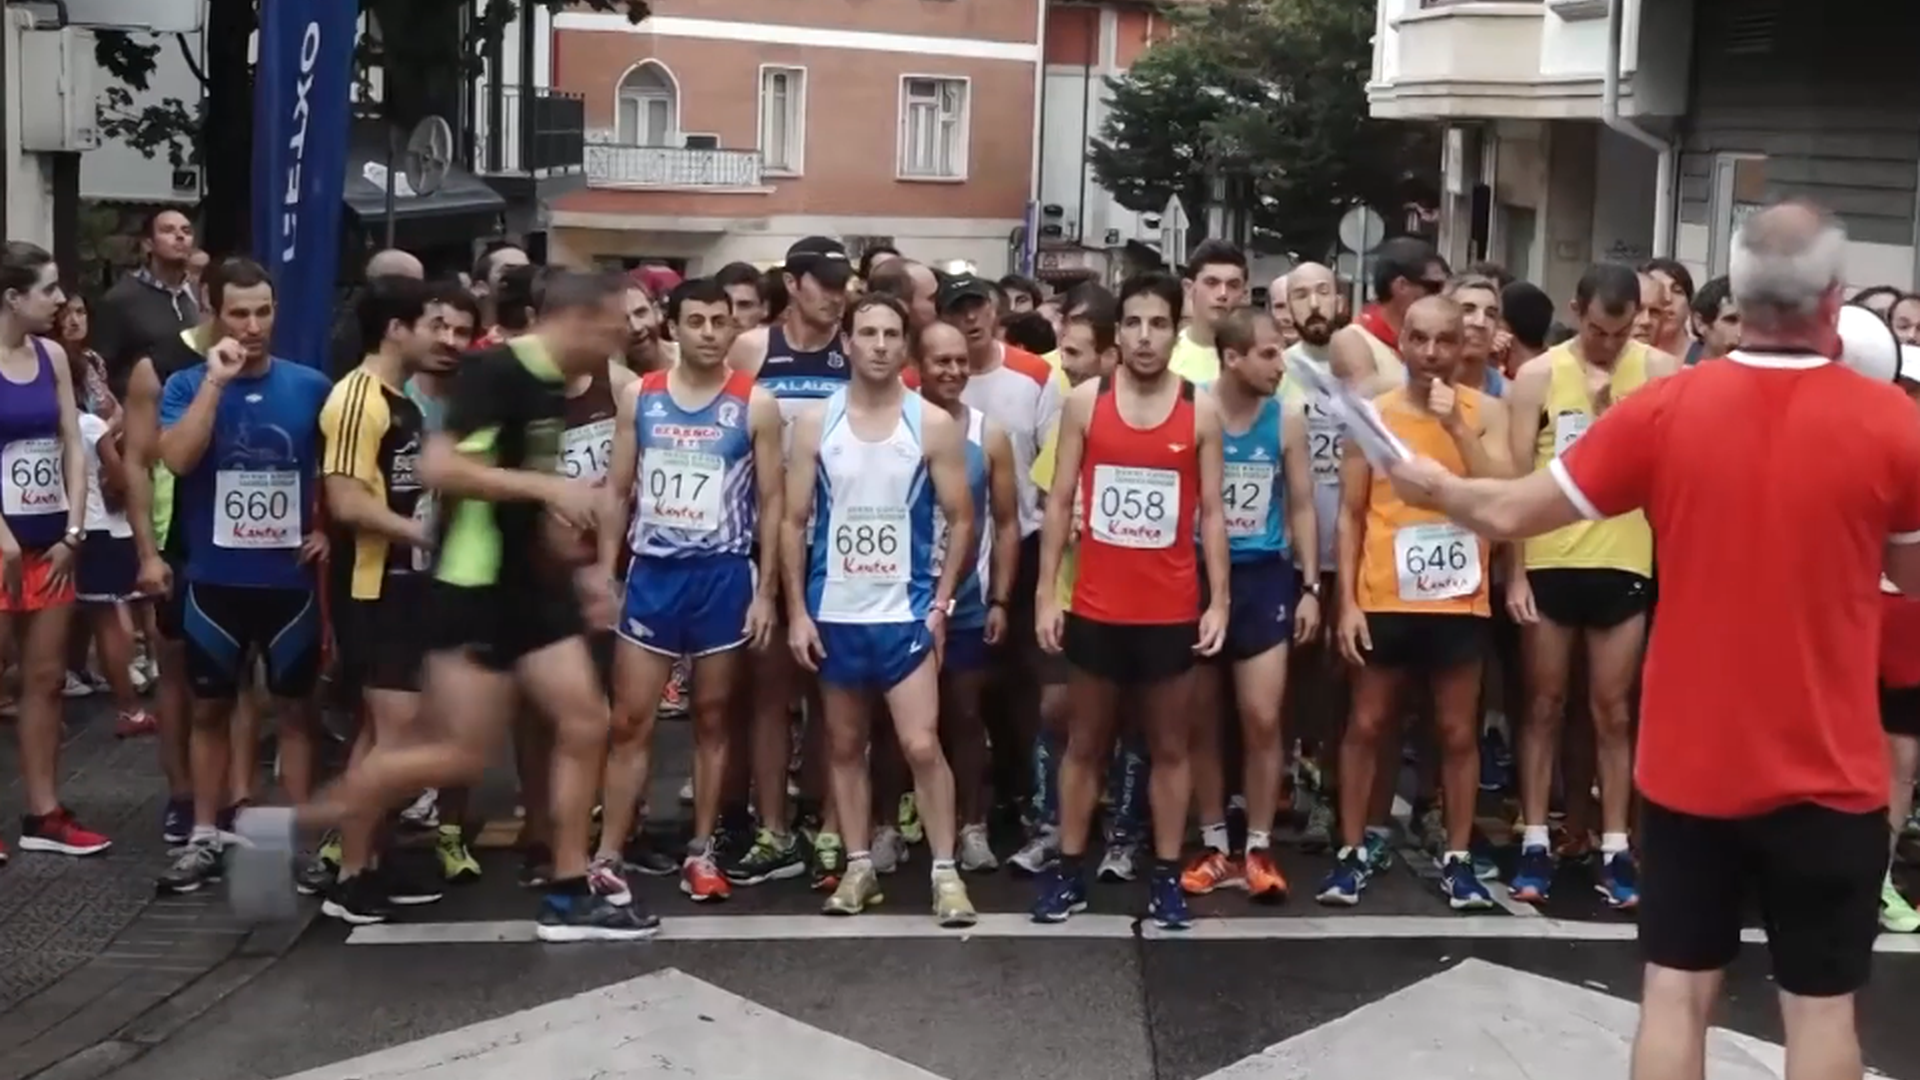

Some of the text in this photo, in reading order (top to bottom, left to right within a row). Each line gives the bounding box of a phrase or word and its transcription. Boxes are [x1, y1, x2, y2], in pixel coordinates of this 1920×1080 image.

[1305, 433, 1343, 460] 26
[650, 468, 710, 500] 017
[1222, 483, 1260, 510] 42
[225, 490, 288, 521] 660
[1101, 486, 1165, 522] 058
[836, 524, 897, 556] 686
[1406, 541, 1467, 575] 646
